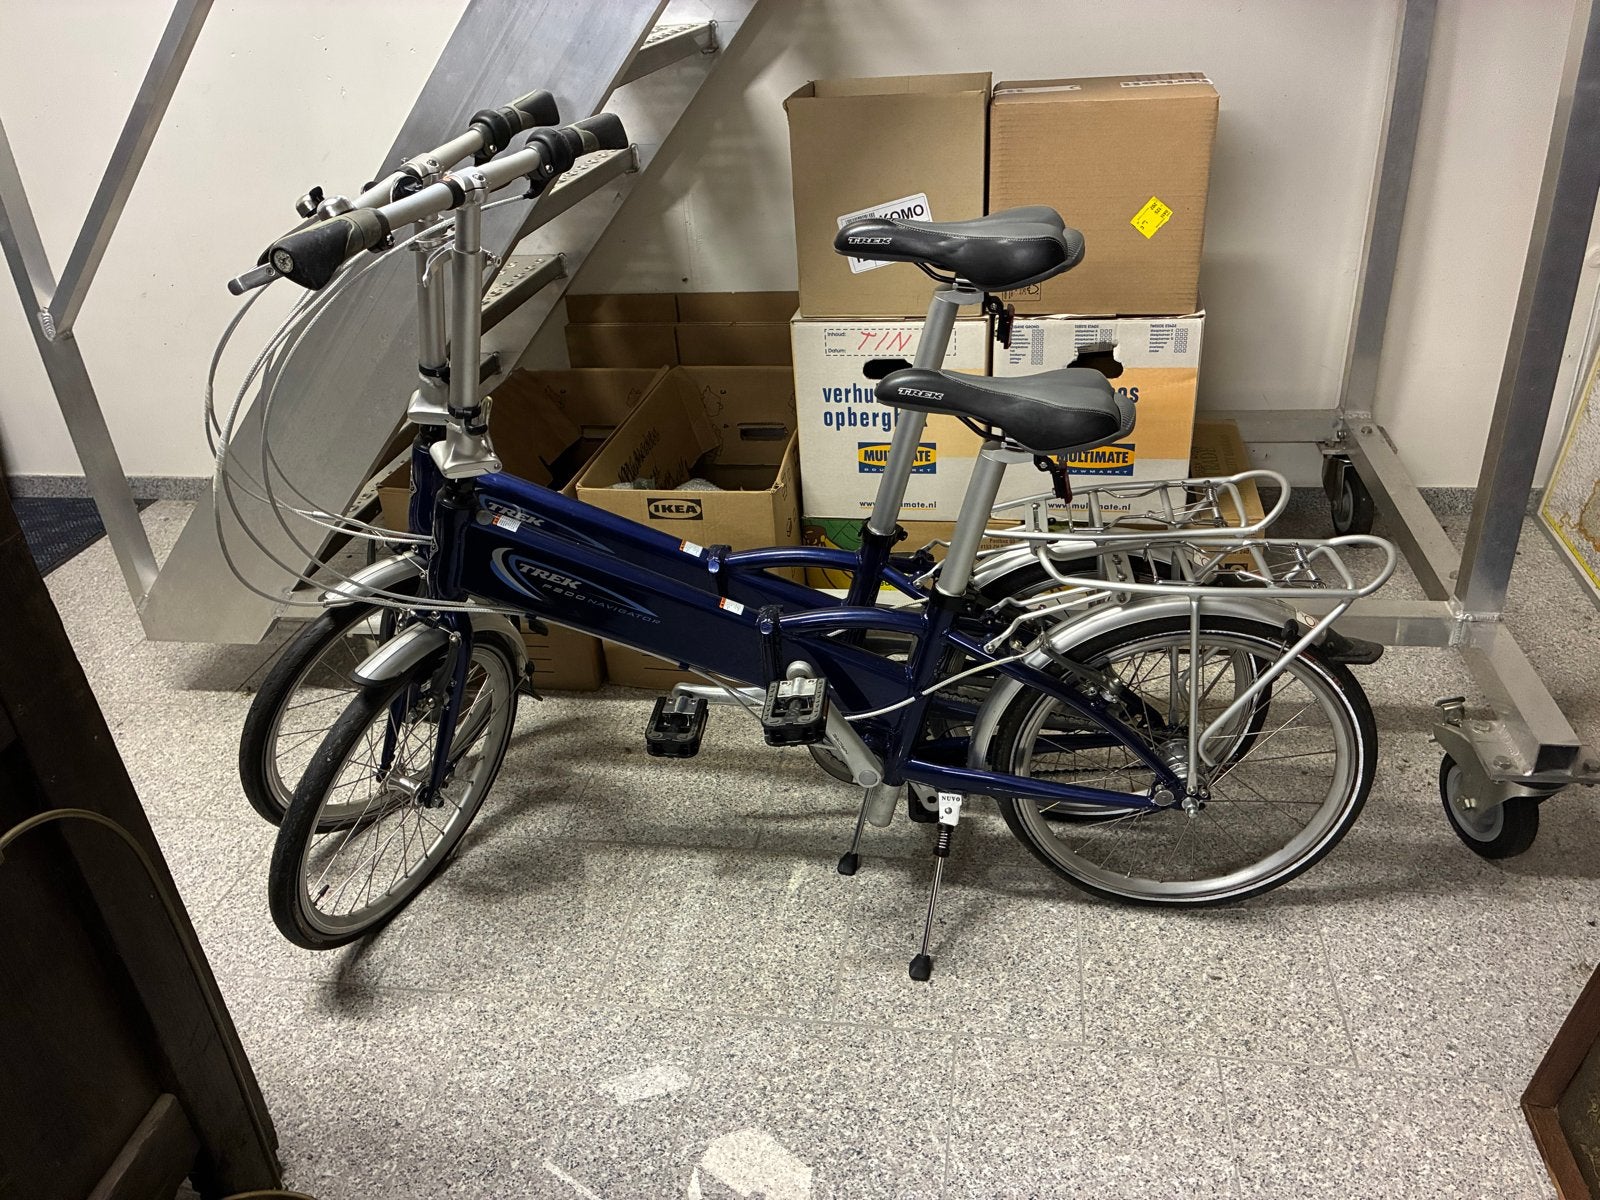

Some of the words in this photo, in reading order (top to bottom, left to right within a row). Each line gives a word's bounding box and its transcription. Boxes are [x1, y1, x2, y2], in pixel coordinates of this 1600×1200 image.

[847, 236, 892, 245] TREK
[857, 331, 913, 352] TIN
[822, 383, 879, 404] verhu
[897, 387, 945, 401] TREK
[487, 501, 546, 528] TREK
[653, 504, 699, 514] IKEA
[519, 562, 583, 590] TREK
